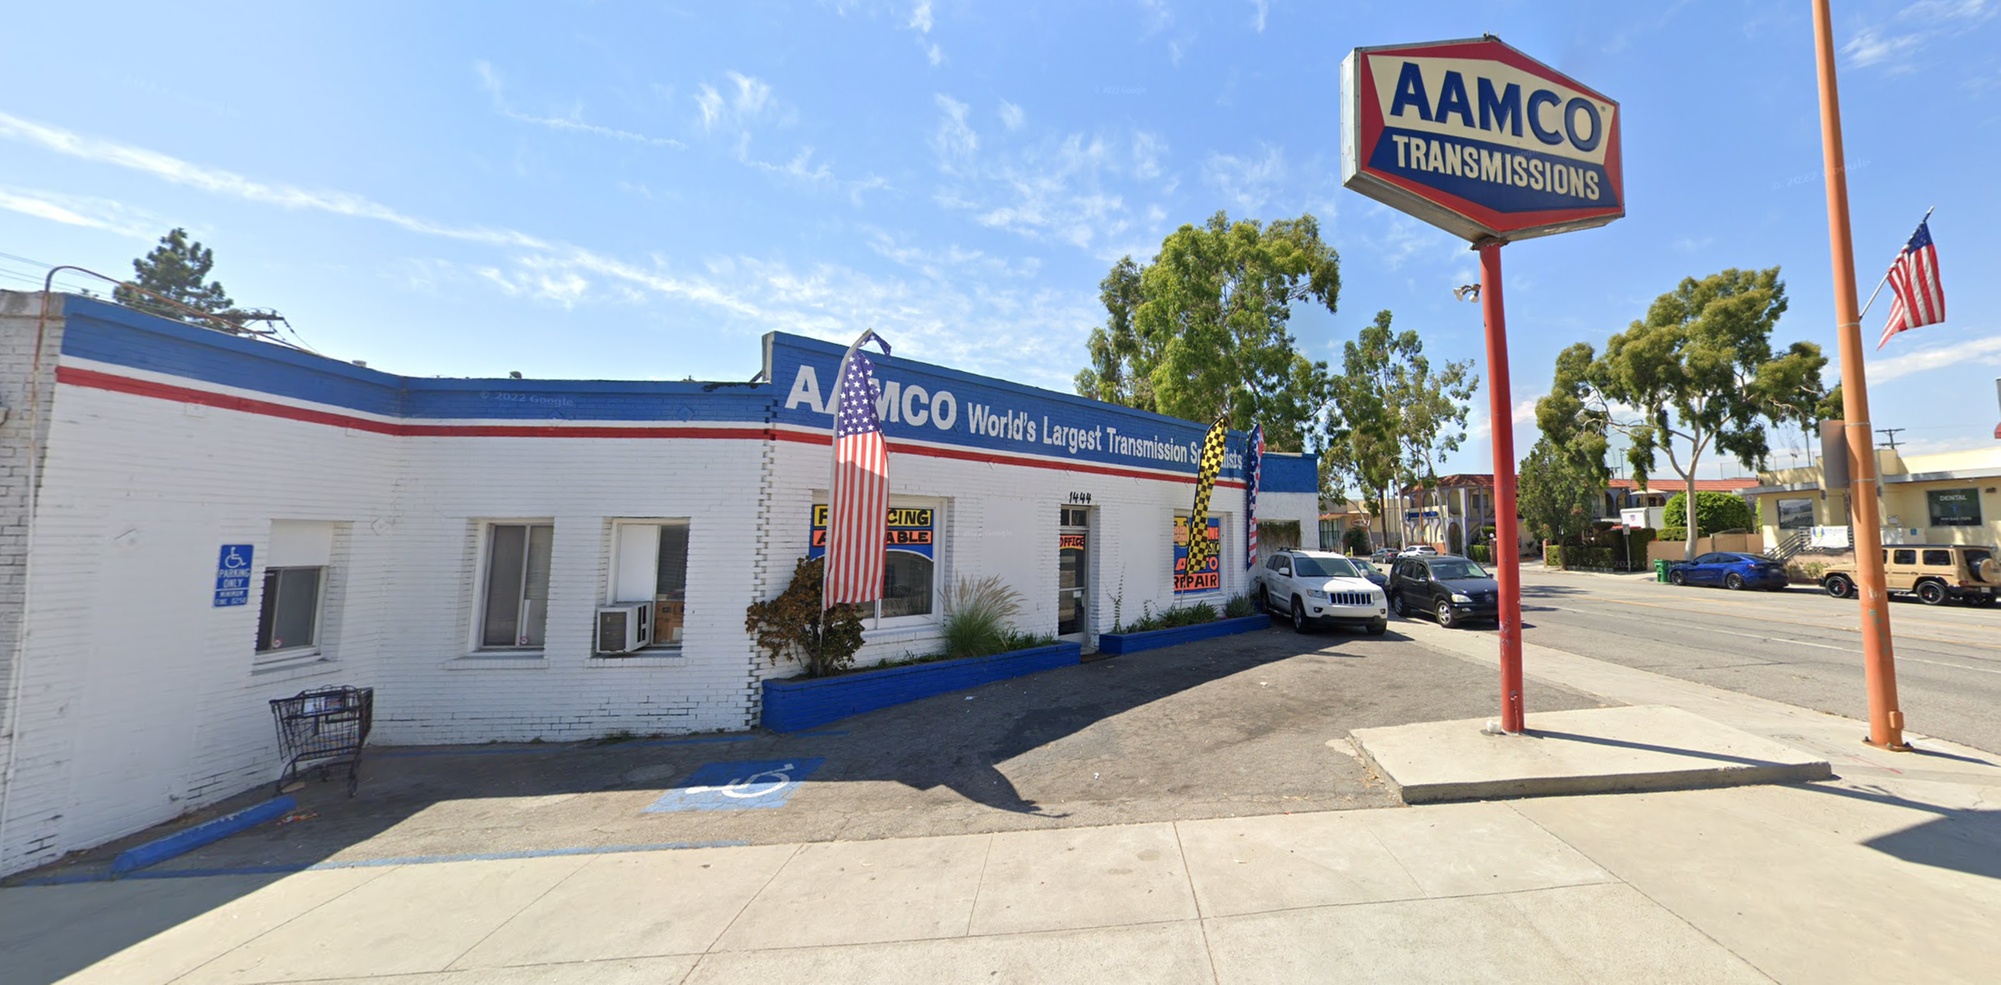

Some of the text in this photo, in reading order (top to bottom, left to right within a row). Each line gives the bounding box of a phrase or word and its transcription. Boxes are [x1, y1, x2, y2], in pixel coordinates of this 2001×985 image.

[1390, 61, 1602, 152] AAMCO
[1392, 134, 1600, 201] TRANSMISSIONS
[967, 402, 1036, 443] World's
[1043, 416, 1102, 454] Largest
[1106, 426, 1188, 463] Transmission
[1069, 491, 1091, 504] 1444
[1059, 537, 1084, 547] OFFICE
[218, 568, 250, 578] PARKING
[223, 578, 244, 588] ONLY
